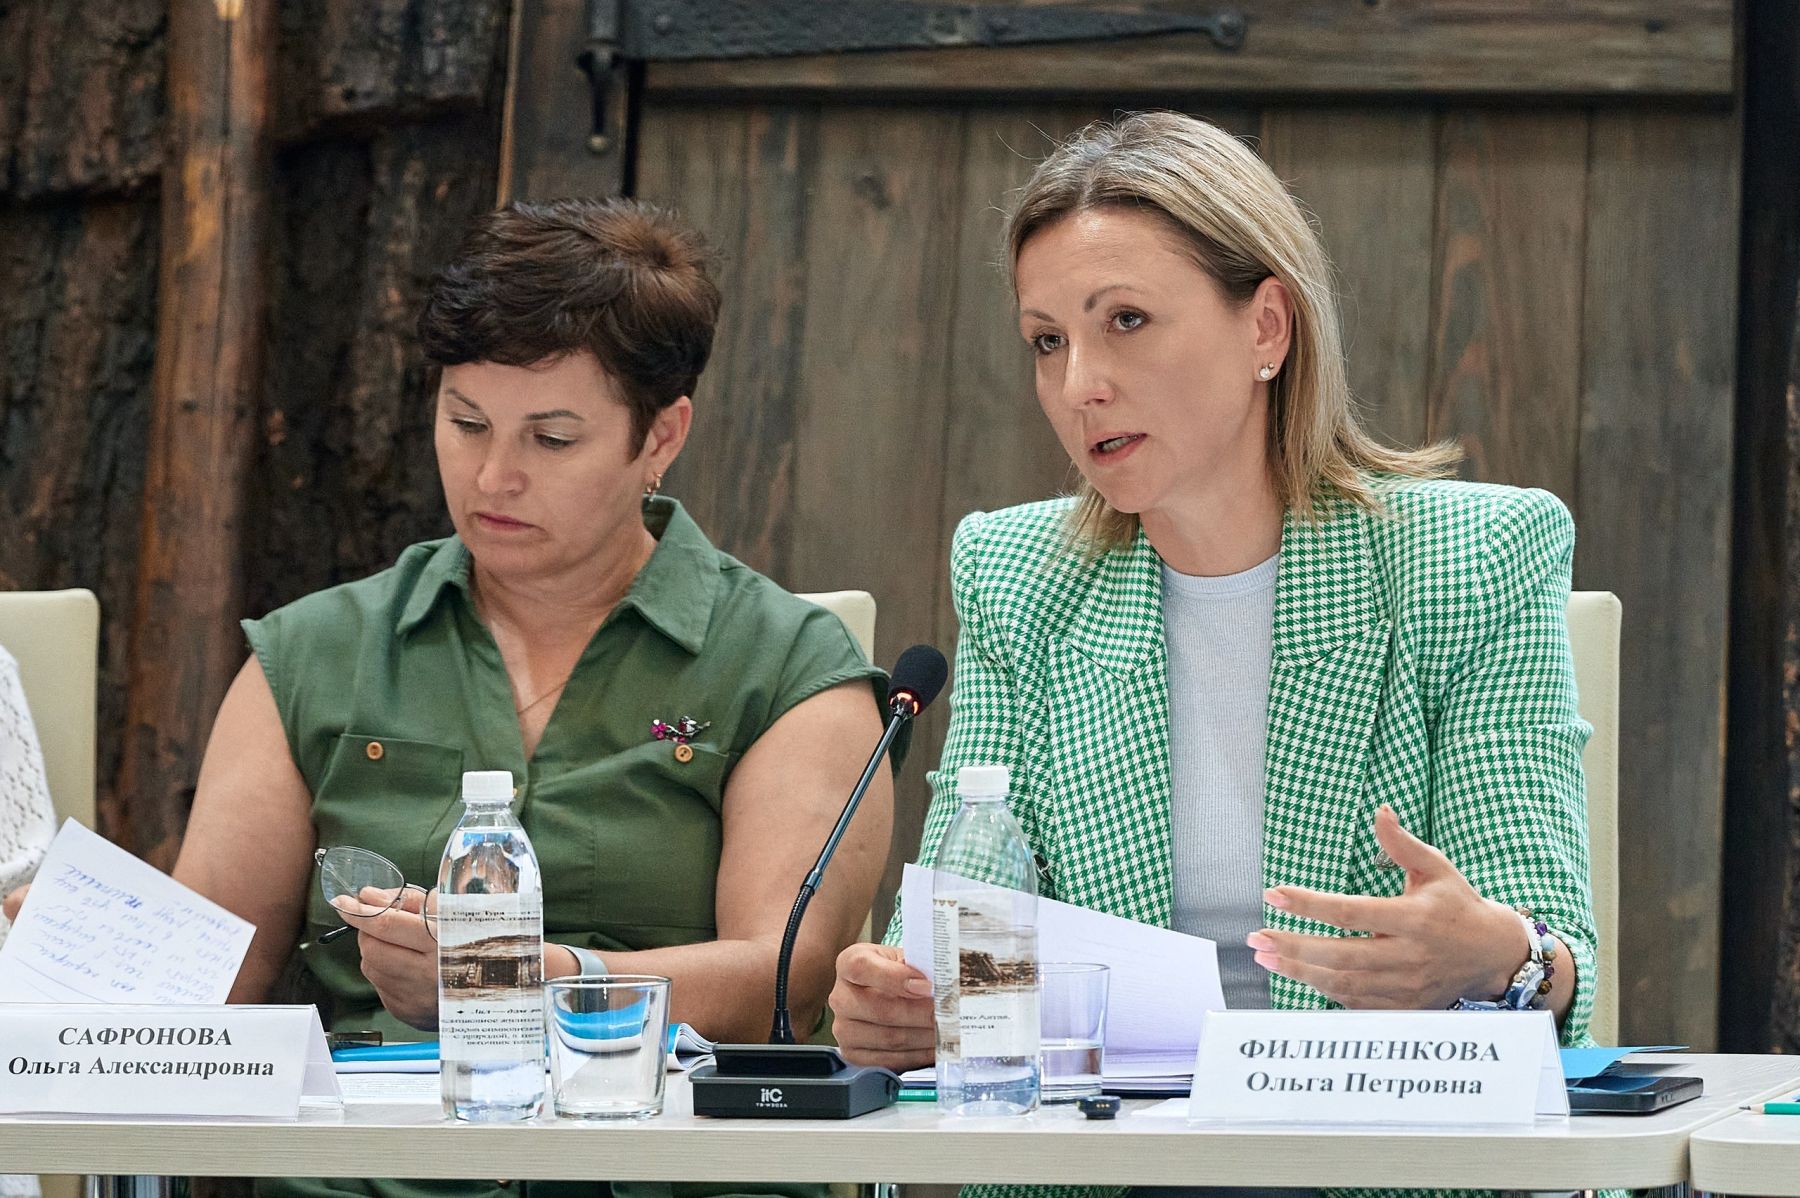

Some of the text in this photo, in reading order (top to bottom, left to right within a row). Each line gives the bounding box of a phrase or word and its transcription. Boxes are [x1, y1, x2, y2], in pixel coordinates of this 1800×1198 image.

[59, 1028, 231, 1045] САФРОНОВА
[1240, 1040, 1499, 1061] ФИЛИПЕНКОВА
[9, 1057, 273, 1079] Ольга Александровна
[1247, 1073, 1481, 1098] Ольга Петровна
